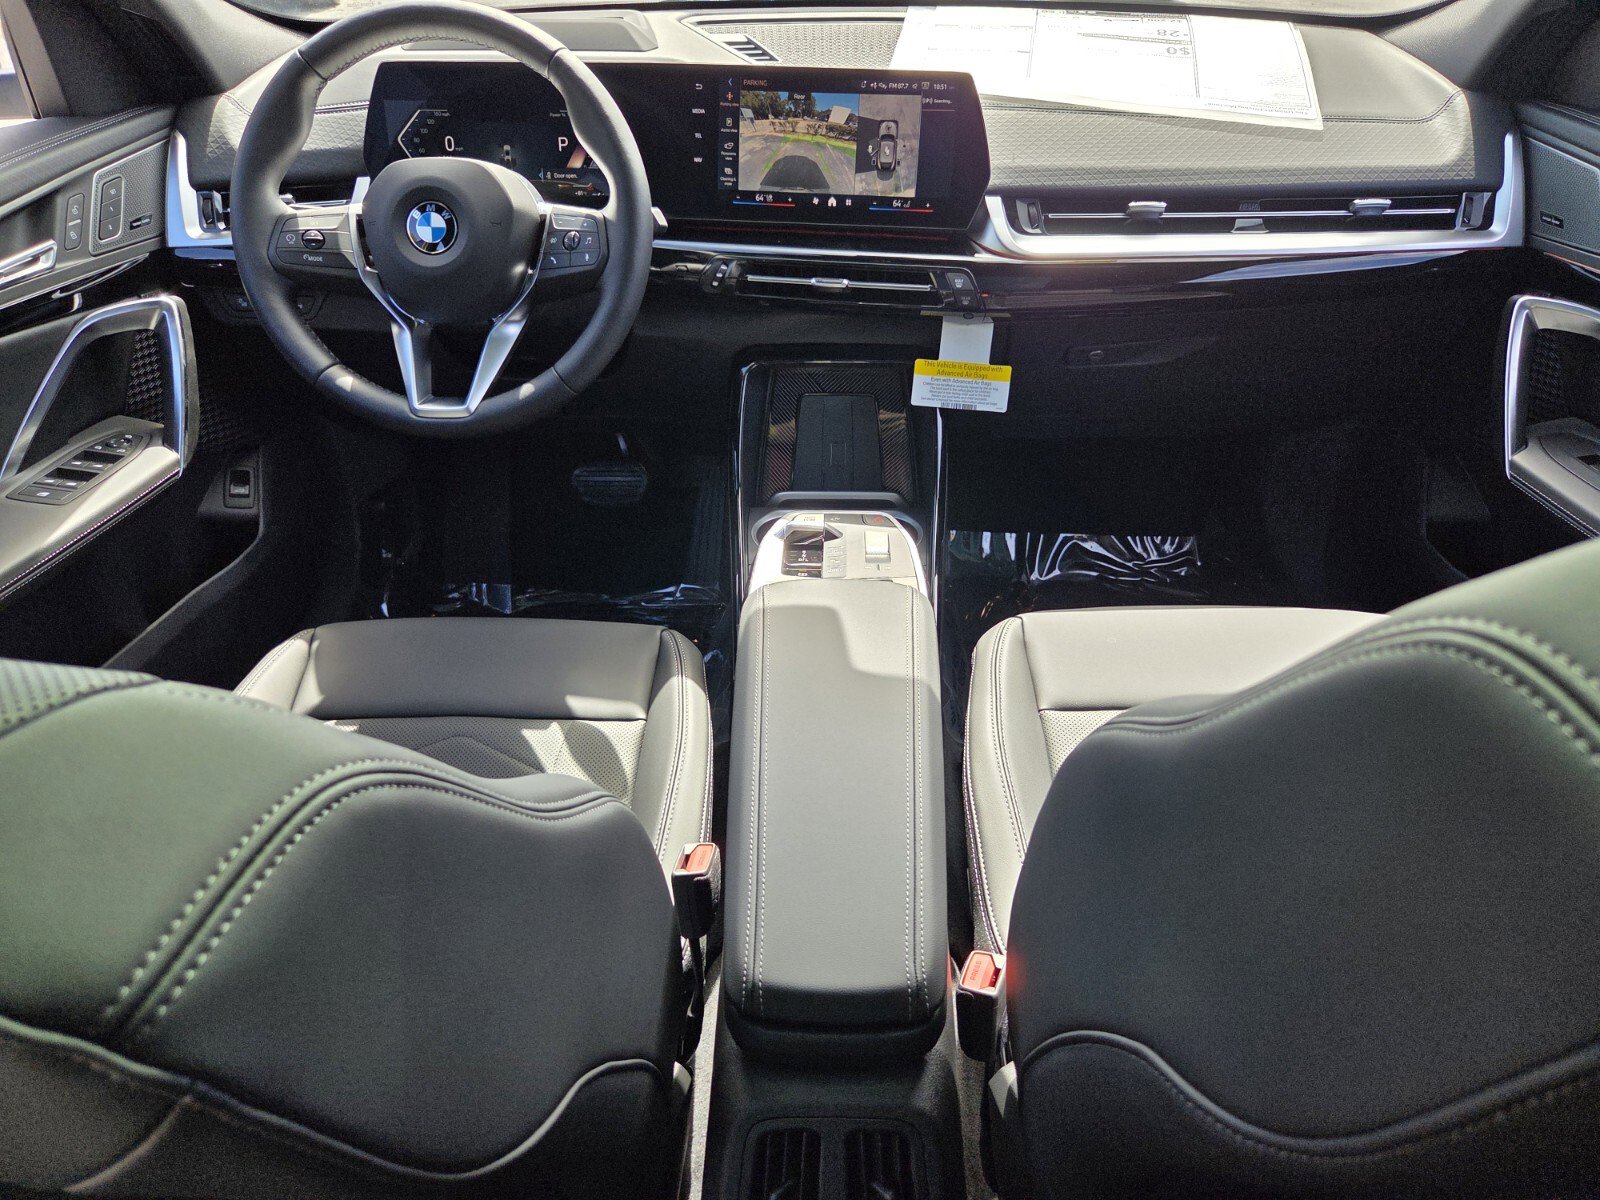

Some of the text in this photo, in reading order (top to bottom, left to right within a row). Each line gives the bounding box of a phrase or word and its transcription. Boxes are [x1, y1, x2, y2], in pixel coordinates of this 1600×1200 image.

[1166, 46, 1190, 55] $0
[444, 136, 454, 151] 0
[558, 136, 568, 152] P
[413, 204, 451, 220] BMW
[936, 369, 964, 378] Advanced
[964, 364, 990, 372] Equipped
